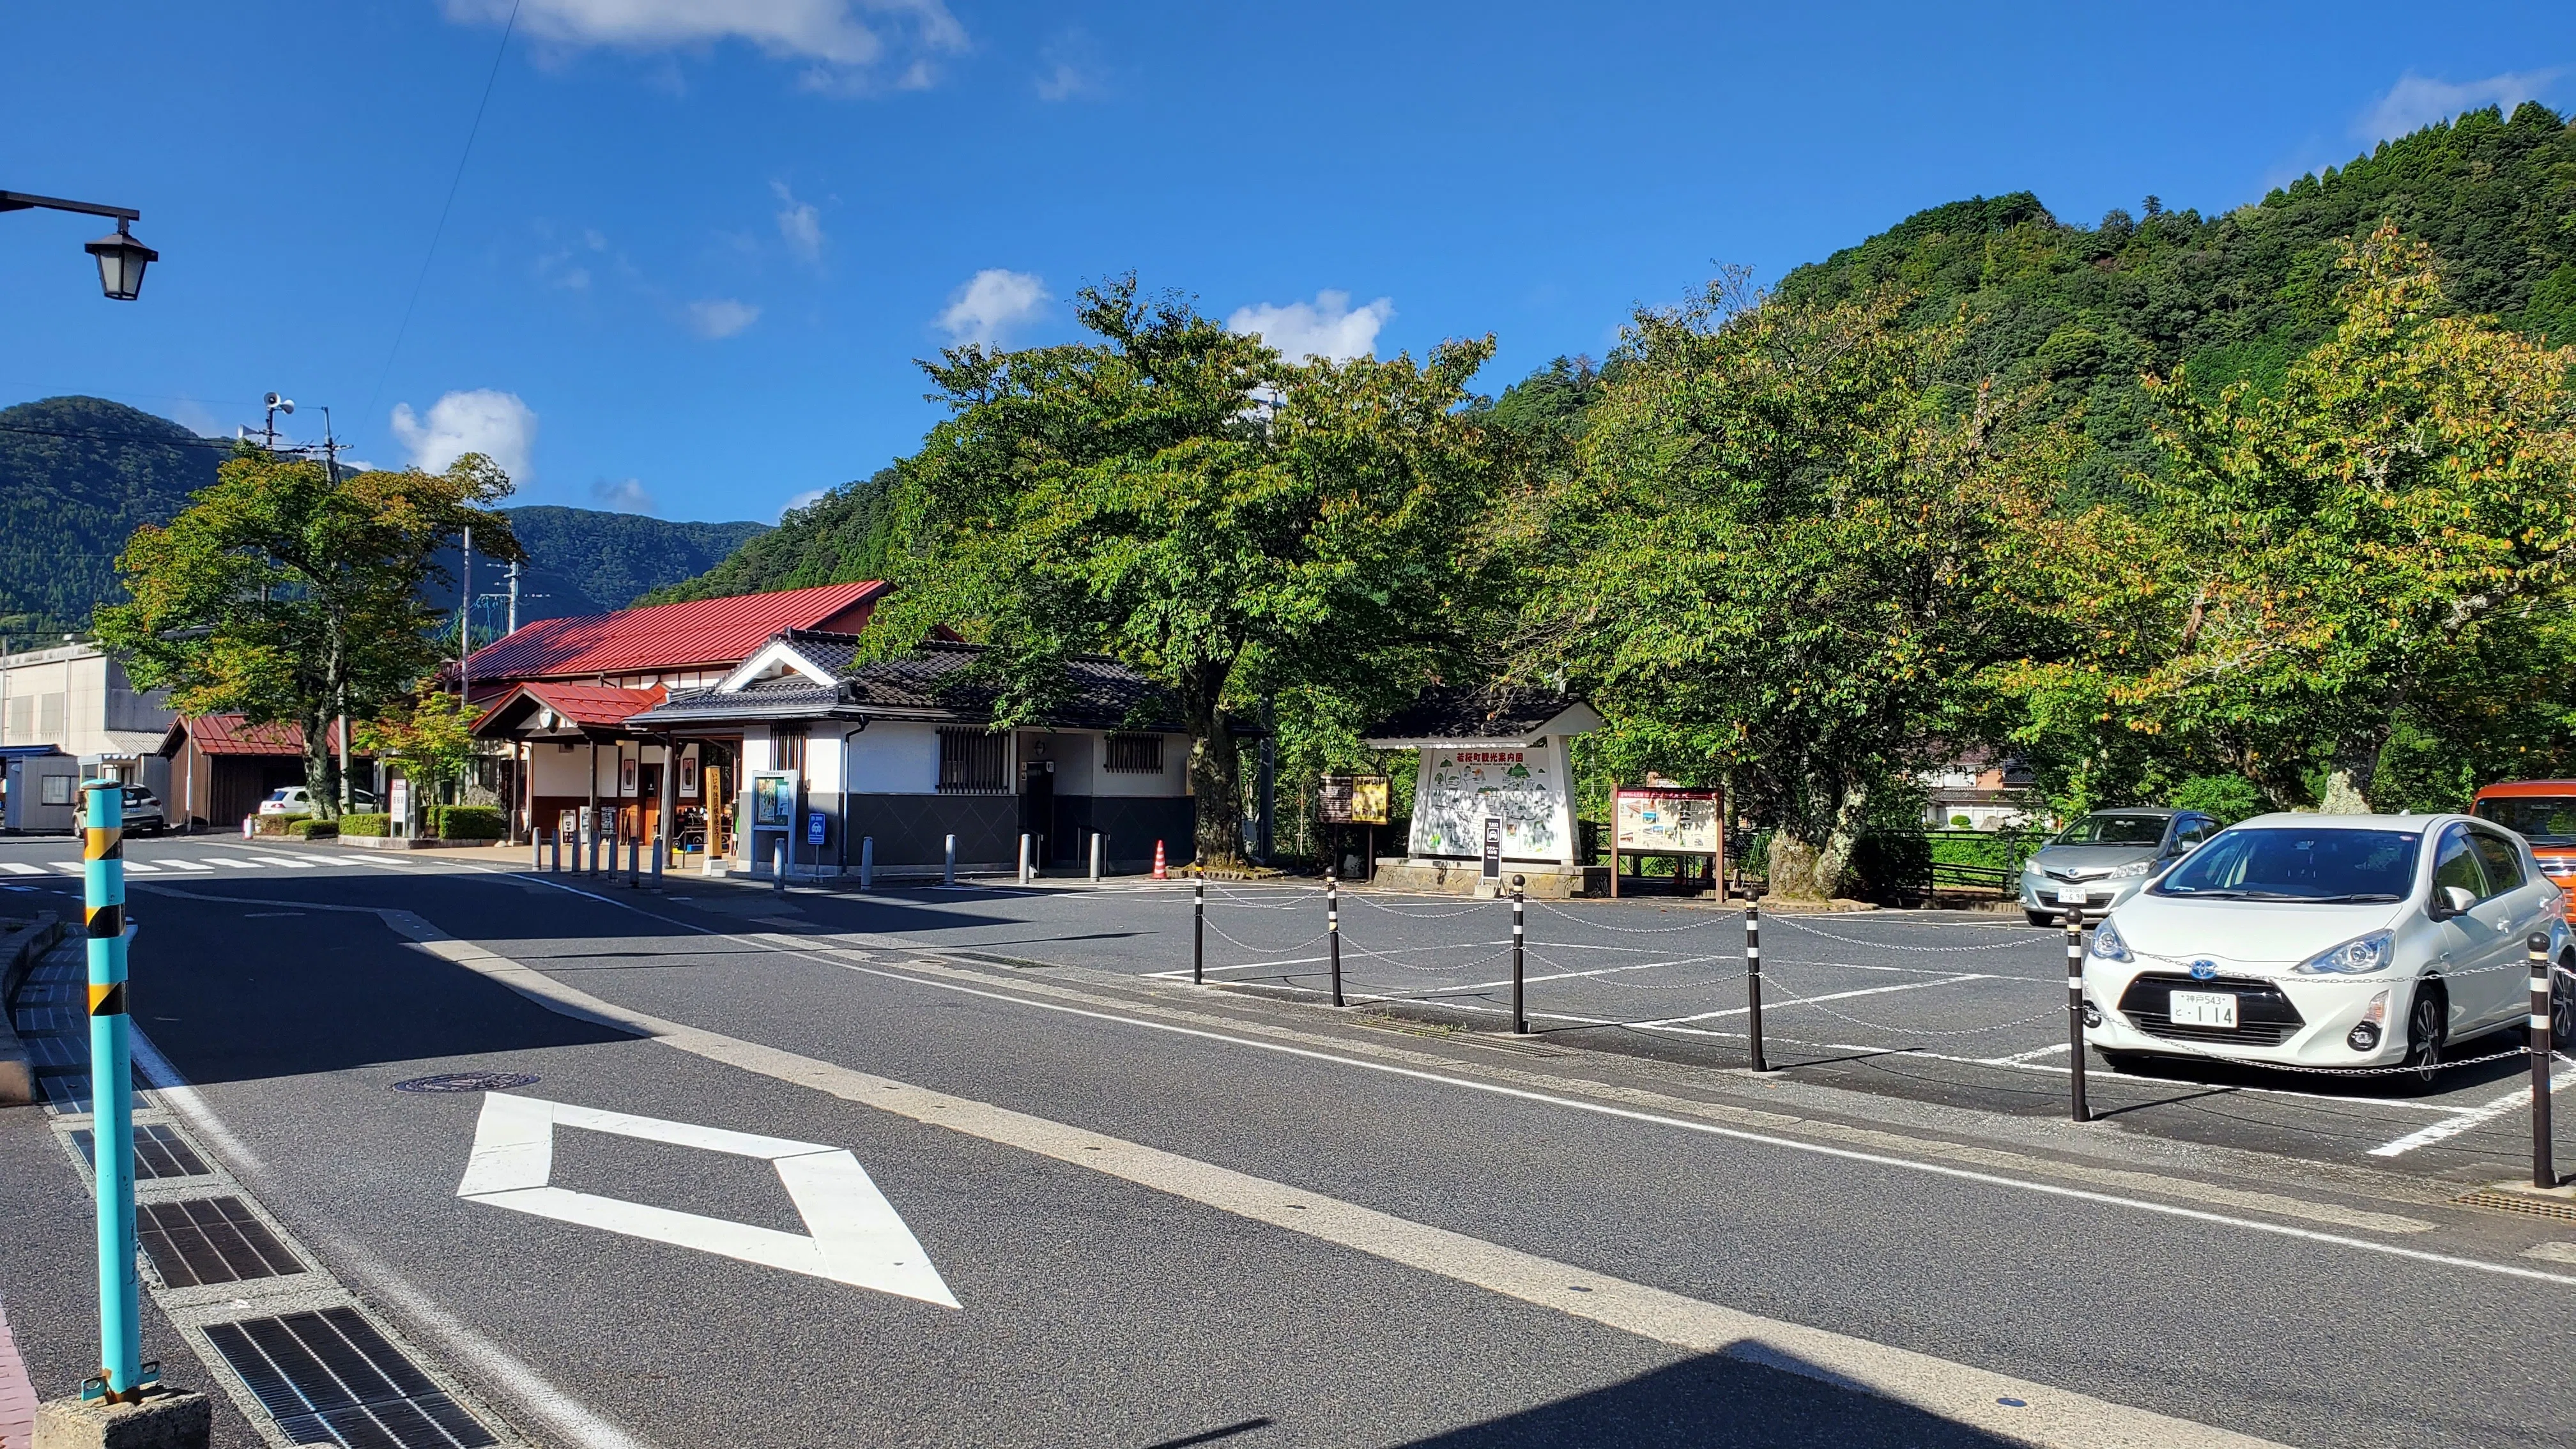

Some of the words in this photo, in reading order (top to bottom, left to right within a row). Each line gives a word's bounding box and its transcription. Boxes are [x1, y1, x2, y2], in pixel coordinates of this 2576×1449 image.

[1457, 752, 1523, 762] 若桜町観光案内図
